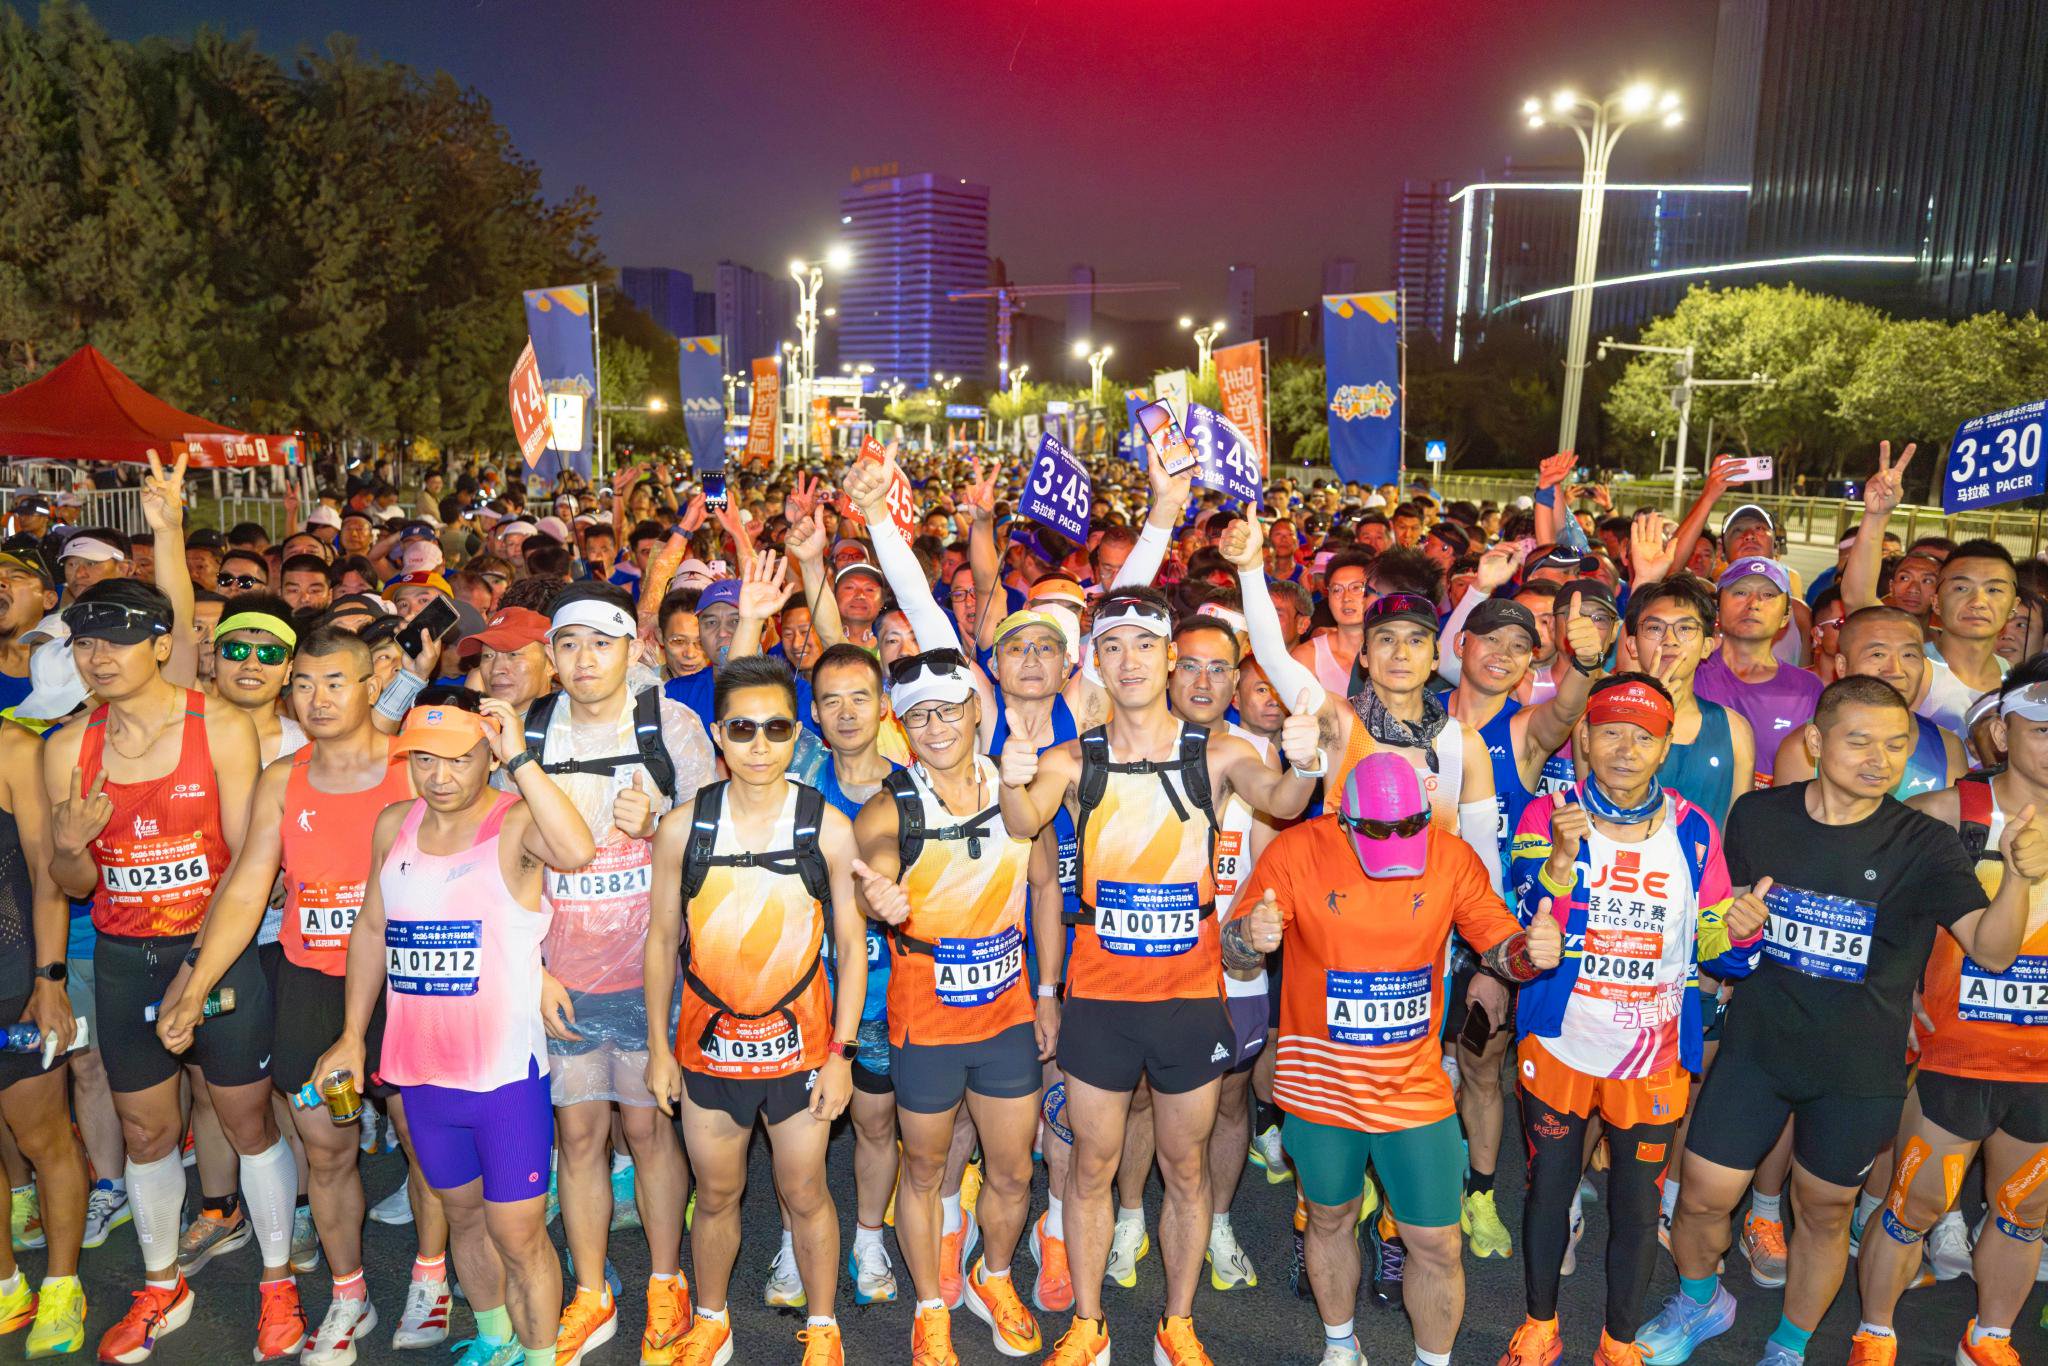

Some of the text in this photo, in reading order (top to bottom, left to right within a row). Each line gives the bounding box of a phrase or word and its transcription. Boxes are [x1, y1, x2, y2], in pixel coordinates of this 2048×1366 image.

[1191, 425, 1259, 485] 3:45
[1952, 423, 2042, 482] 3:30
[1033, 456, 1089, 519] 3:45
[1230, 479, 1255, 499] PACER
[1957, 475, 2033, 502] 马拉松 PACER
[886, 479, 912, 523] 45
[1031, 500, 1082, 535] 马拉松 PACER
[1537, 777, 1549, 794] A
[108, 859, 203, 887] A 02366
[557, 868, 647, 894] A 03821
[1133, 895, 1194, 903] 2026乌鲁木齐马拉松
[306, 910, 320, 929] A
[1101, 910, 1194, 933] A 00175
[1634, 919, 1664, 933] OPEN
[1795, 905, 1866, 926] 2026乌鲁木齐马拉松
[413, 932, 475, 940] 2026乌鲁木齐马拉松
[1785, 922, 1863, 956] 01136
[391, 949, 475, 971] A 01212
[940, 966, 956, 985] A
[967, 949, 1019, 984] 01735
[1584, 954, 1654, 980] 02084
[1370, 979, 1427, 992] 2026乌鲁木齐马拉松
[1967, 979, 2048, 1004] A 012
[1334, 996, 1427, 1022] A 01085
[708, 1031, 798, 1058] A 03398
[1211, 1048, 1230, 1063] PEAK
